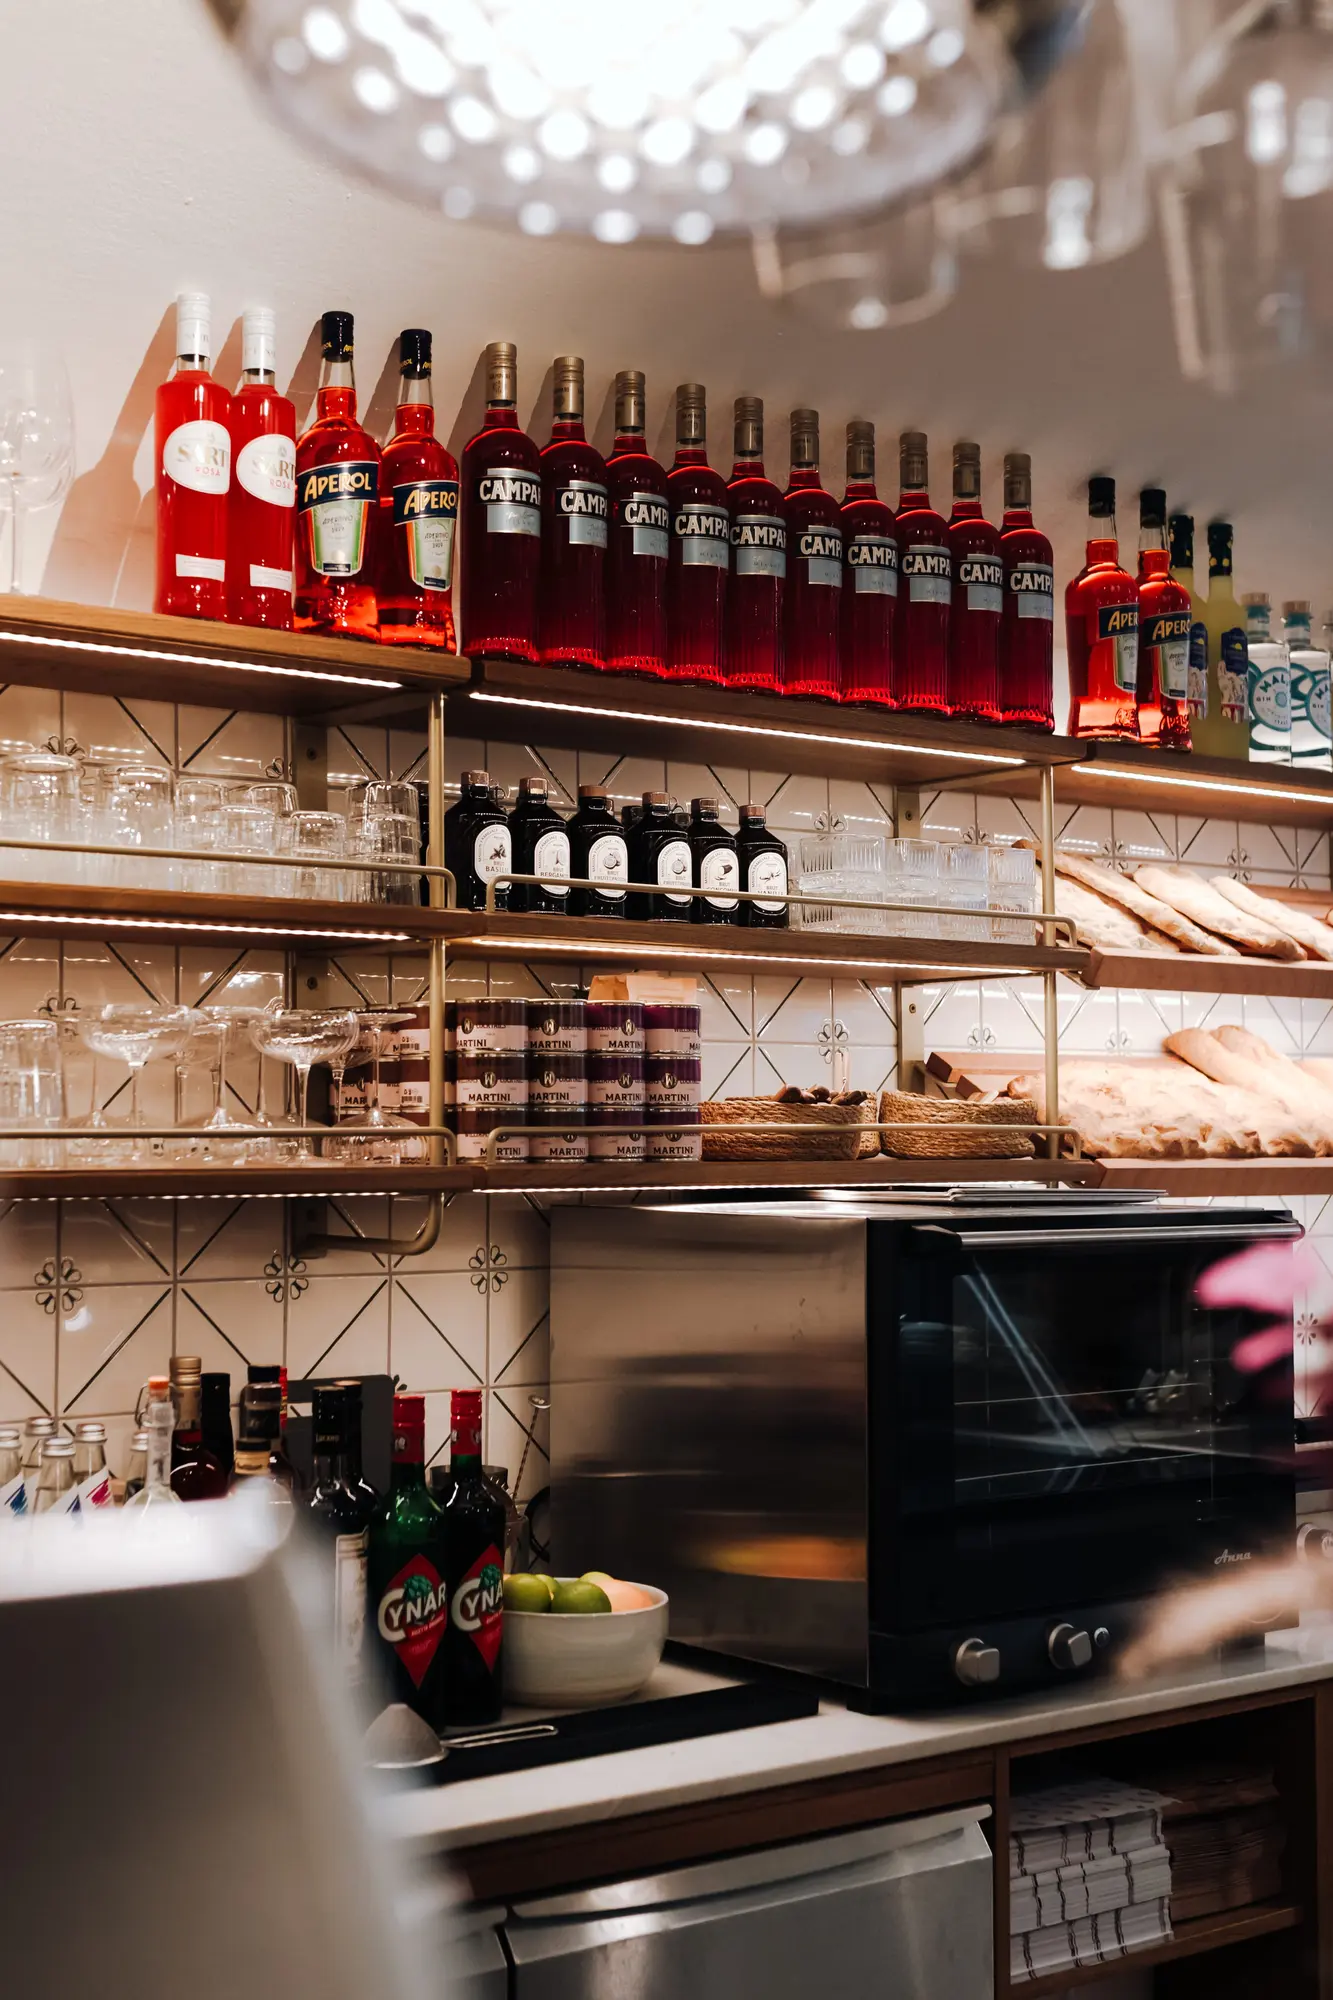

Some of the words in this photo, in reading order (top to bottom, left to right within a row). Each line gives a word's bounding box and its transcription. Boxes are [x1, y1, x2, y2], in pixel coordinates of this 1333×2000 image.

[304, 472, 372, 503] APEROL
[403, 489, 458, 515] APERO
[529, 1040, 572, 1049] MARTINI
[468, 1093, 511, 1102] MARTINI
[528, 1092, 569, 1101] MARTINI
[649, 1093, 690, 1102] MARTINI
[480, 1147, 521, 1156] MRTINI
[549, 1147, 586, 1156] MARTINI
[653, 1146, 694, 1155] MARTINI
[1213, 1548, 1251, 1565] Anna
[378, 1581, 447, 1643] CYNAR
